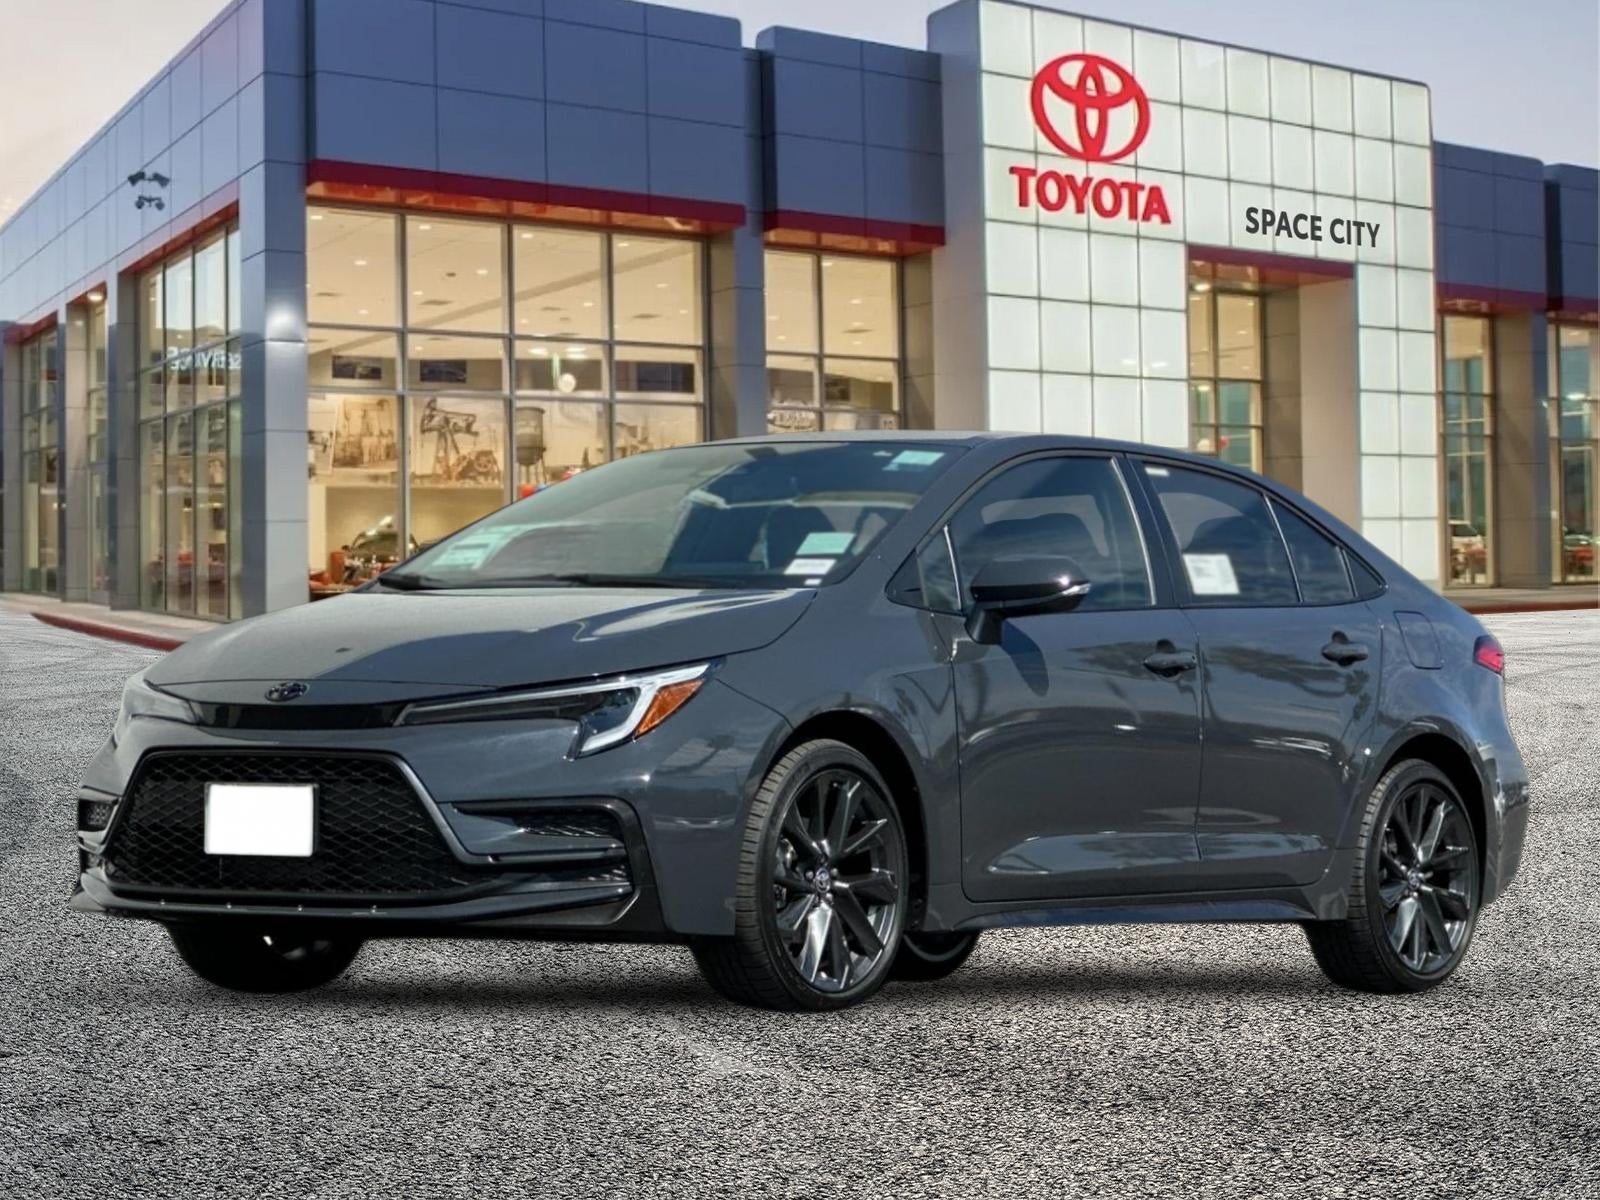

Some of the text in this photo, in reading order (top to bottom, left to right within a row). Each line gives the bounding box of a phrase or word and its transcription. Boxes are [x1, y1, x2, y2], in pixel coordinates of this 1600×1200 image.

[1010, 166, 1171, 224] TOYOTA
[1245, 206, 1381, 248] SPACE CITY
